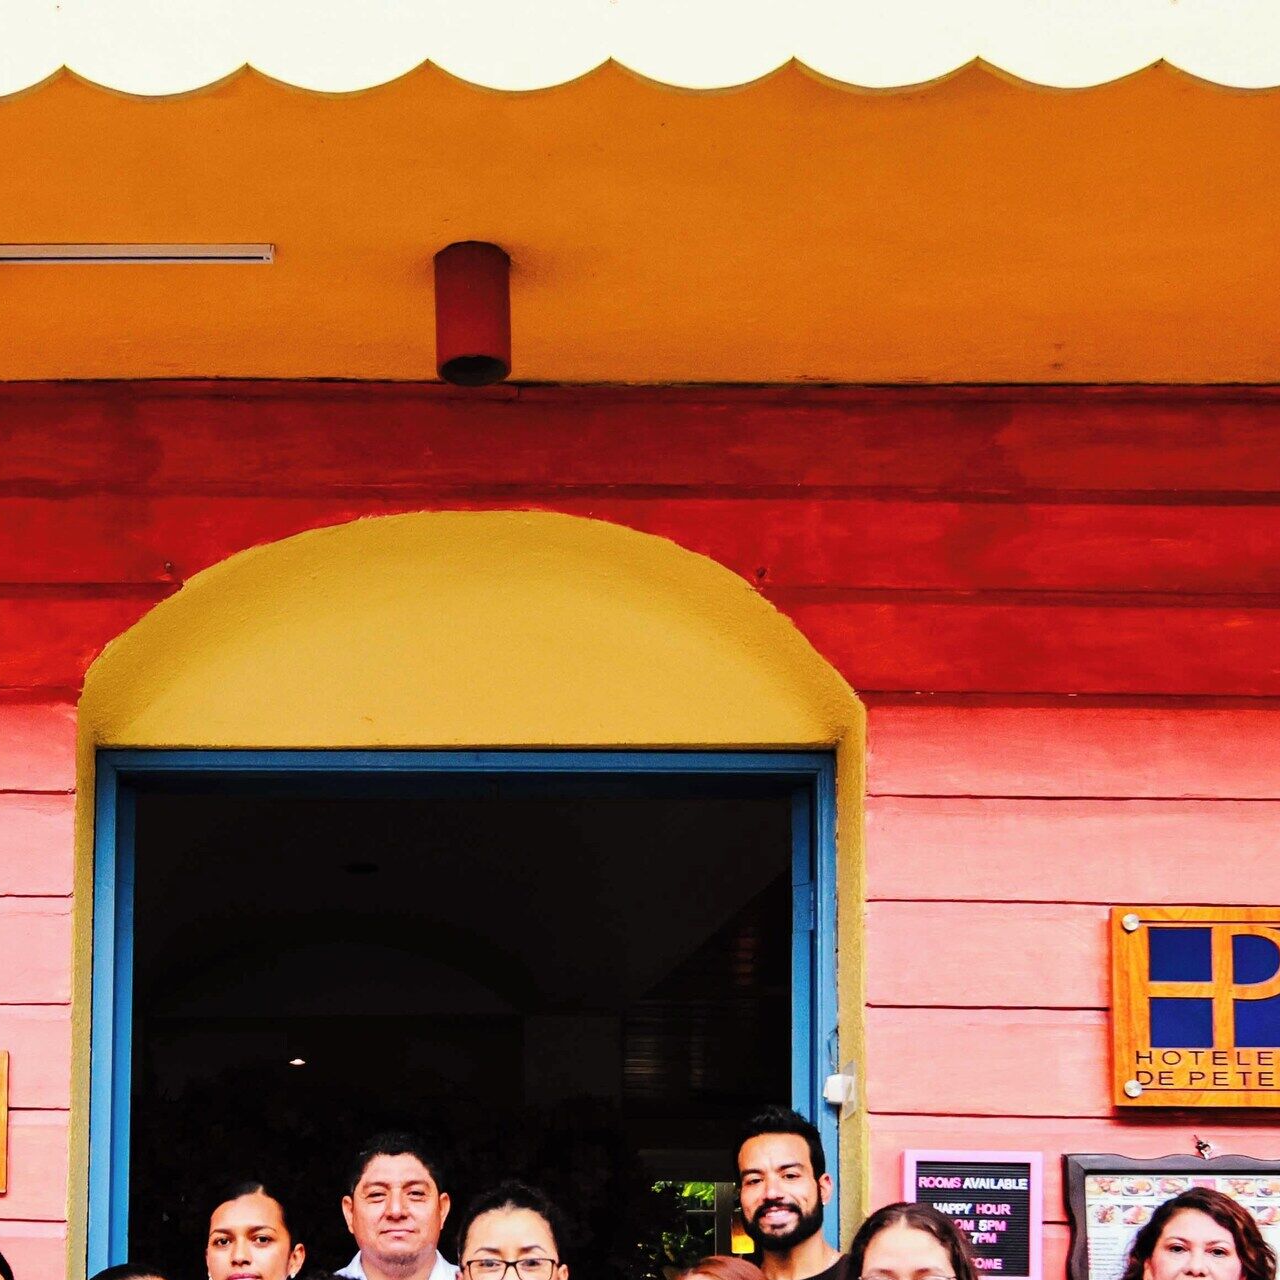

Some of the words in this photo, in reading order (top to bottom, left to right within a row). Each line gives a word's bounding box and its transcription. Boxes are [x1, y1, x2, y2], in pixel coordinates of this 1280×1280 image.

[1135, 1071, 1174, 1086] DE
[918, 1176, 961, 1190] ROOMS
[962, 1177, 1028, 1191] AVAILABLE
[932, 1202, 972, 1215] HAPPY
[975, 1203, 1011, 1216] HOUR
[978, 1219, 1007, 1233] 5PM
[970, 1232, 997, 1245] 7PM
